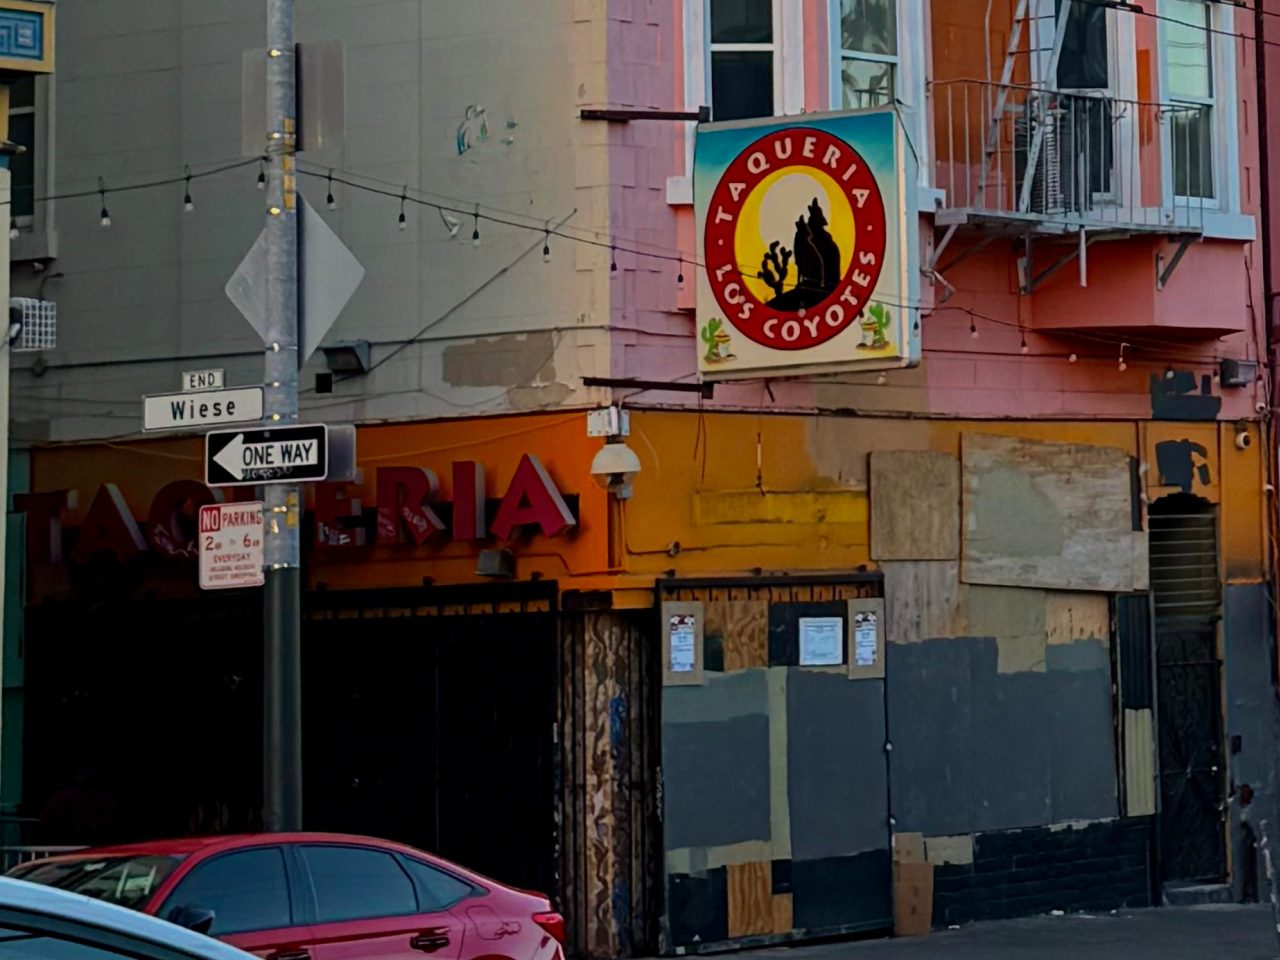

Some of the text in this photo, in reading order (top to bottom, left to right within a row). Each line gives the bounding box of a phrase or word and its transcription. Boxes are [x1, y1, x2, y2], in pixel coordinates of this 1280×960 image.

[715, 136, 870, 224] TAQUERIA
[716, 263, 755, 320] LOS
[763, 250, 876, 342] COYOTES
[190, 372, 215, 388] END
[171, 400, 236, 421] Wiese
[243, 442, 313, 467] ONE WAY
[14, 453, 576, 564] TAQERIA
[203, 509, 262, 531] NO PARKING
[213, 553, 251, 563] EVERYDAY
